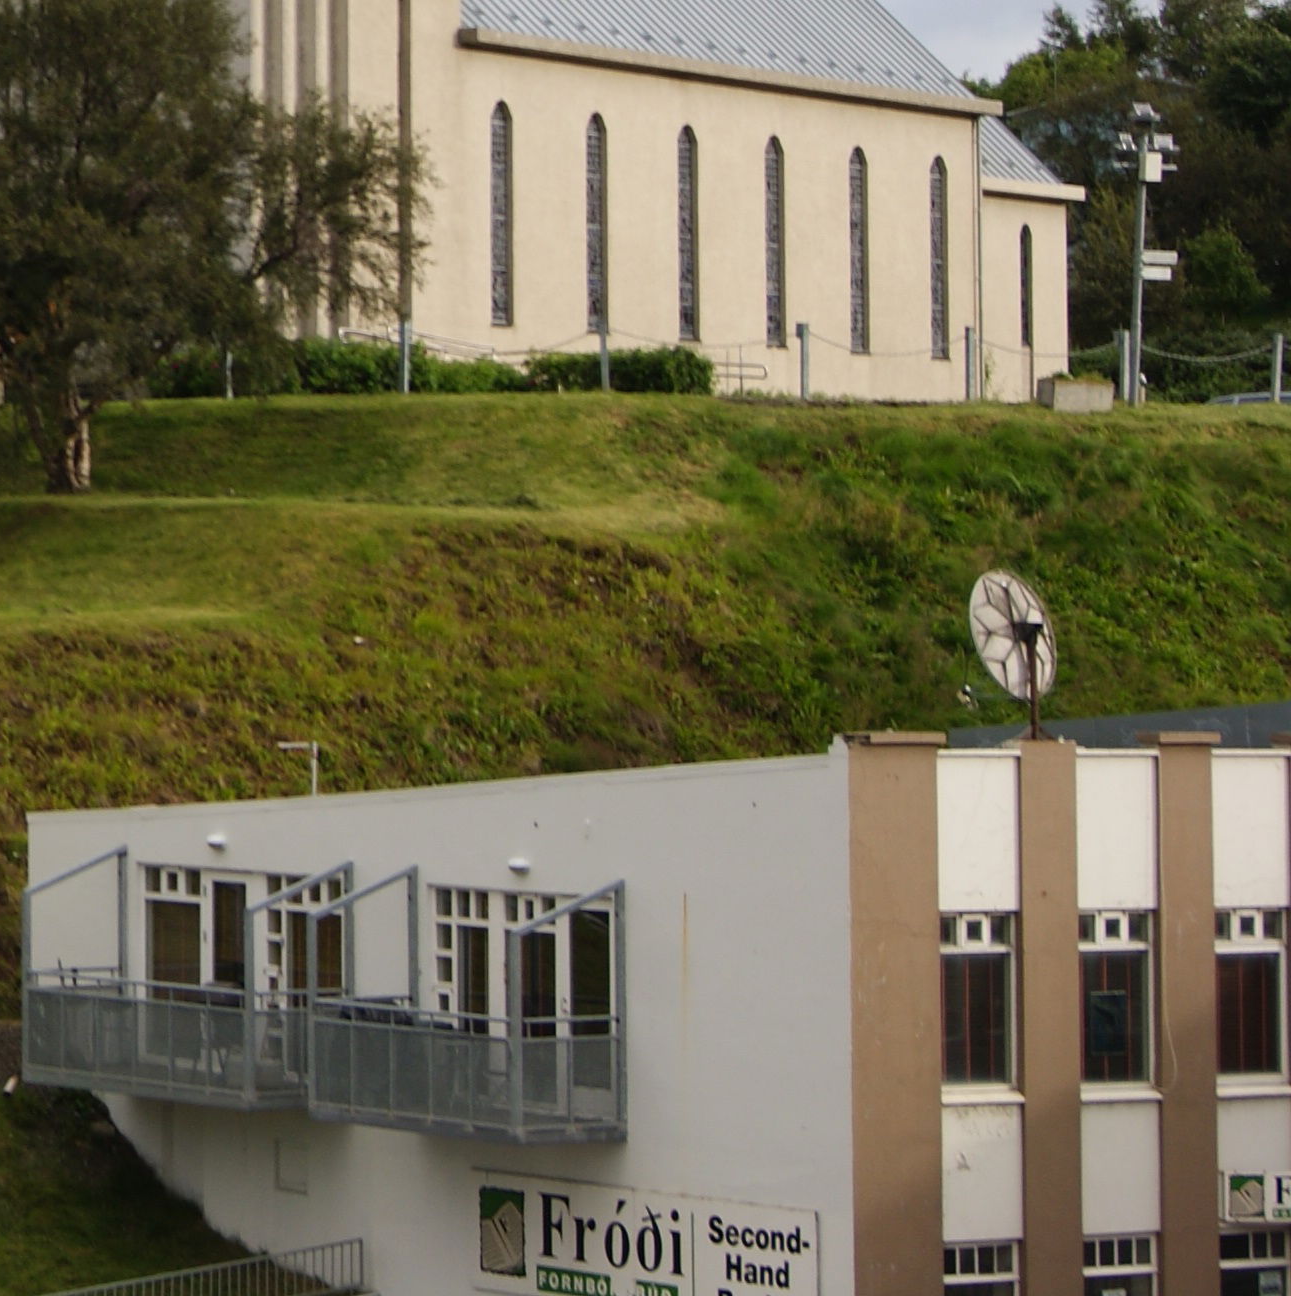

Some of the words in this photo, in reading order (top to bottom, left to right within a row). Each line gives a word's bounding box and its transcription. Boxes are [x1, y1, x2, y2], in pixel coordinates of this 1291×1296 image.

[538, 1191, 684, 1277] Fróði
[708, 1215, 810, 1254] Second-
[725, 1252, 790, 1289] Hand
